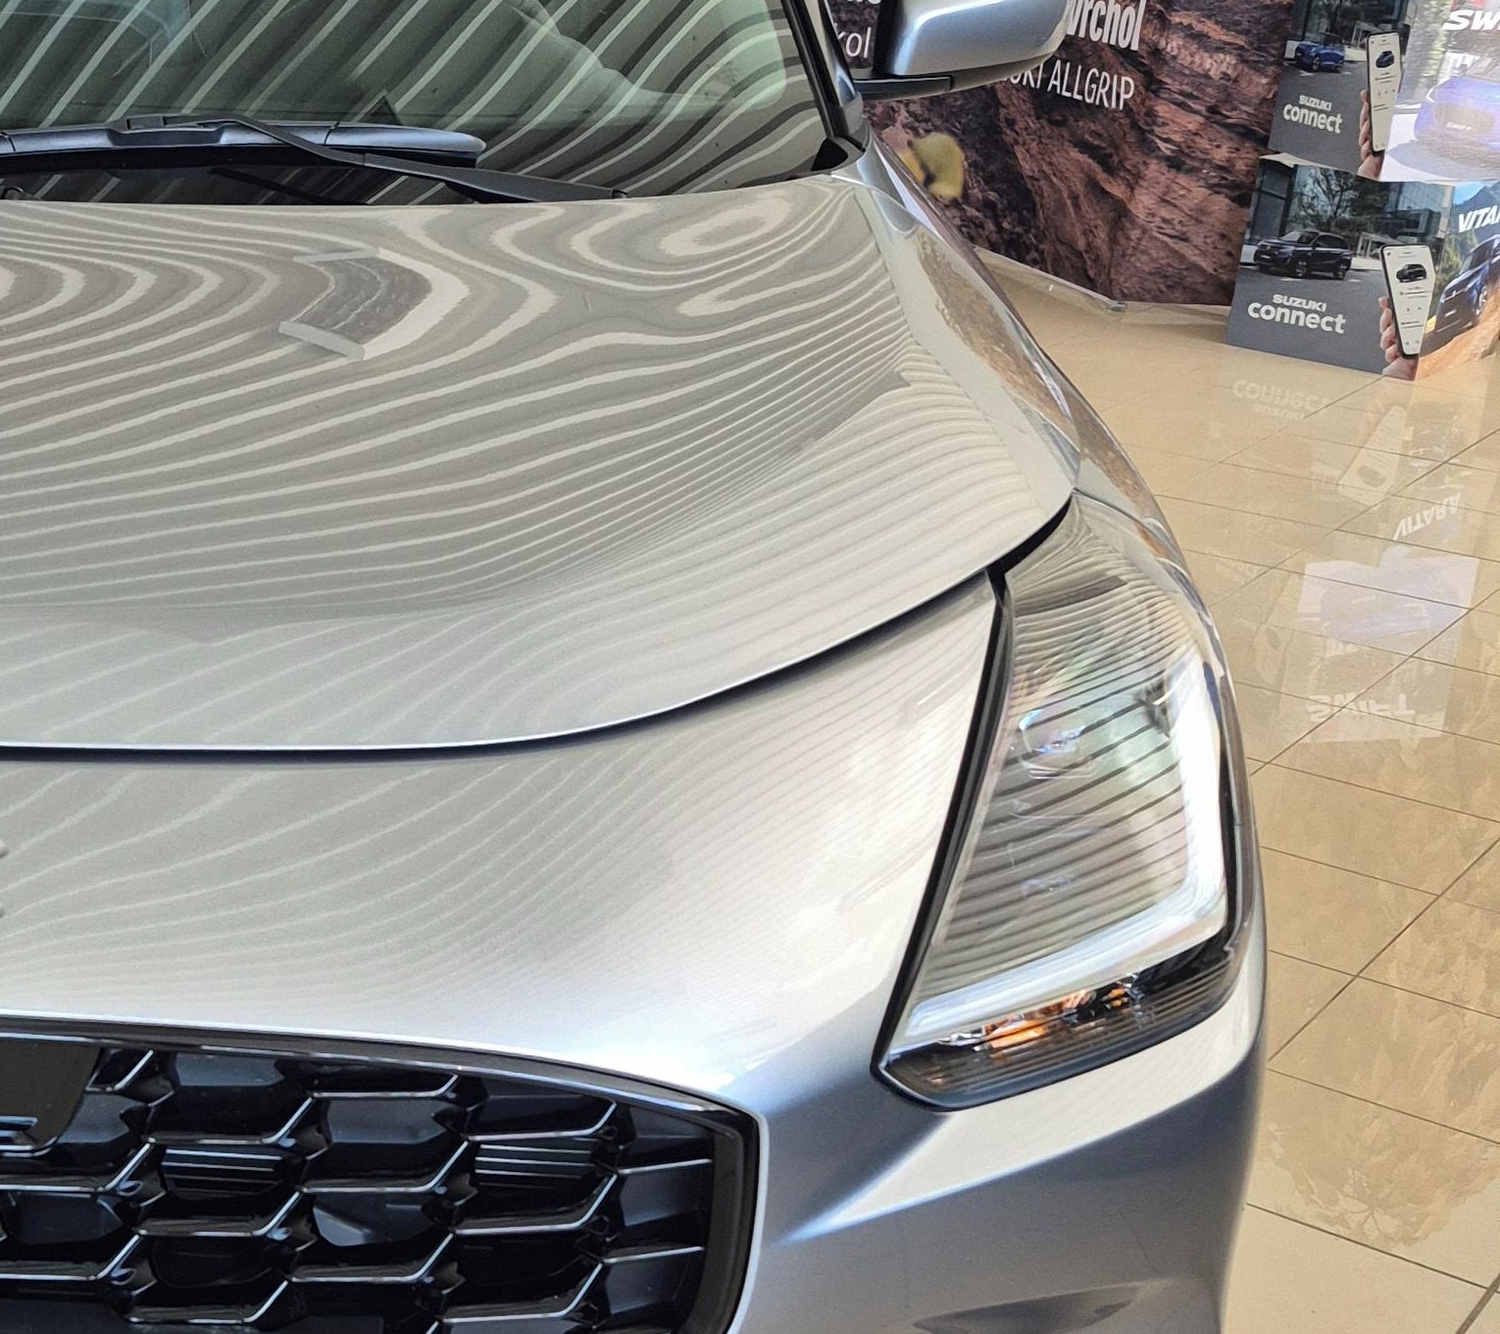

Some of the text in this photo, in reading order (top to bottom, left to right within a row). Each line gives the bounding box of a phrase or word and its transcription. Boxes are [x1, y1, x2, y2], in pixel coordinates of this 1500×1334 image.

[1048, 58, 1136, 111] ALLGRIP
[1299, 94, 1333, 111] SUZUKI
[1283, 103, 1343, 134] connect
[1458, 205, 1500, 233] VITA
[1272, 293, 1328, 312] SUZUKI
[1247, 302, 1347, 334] connect
